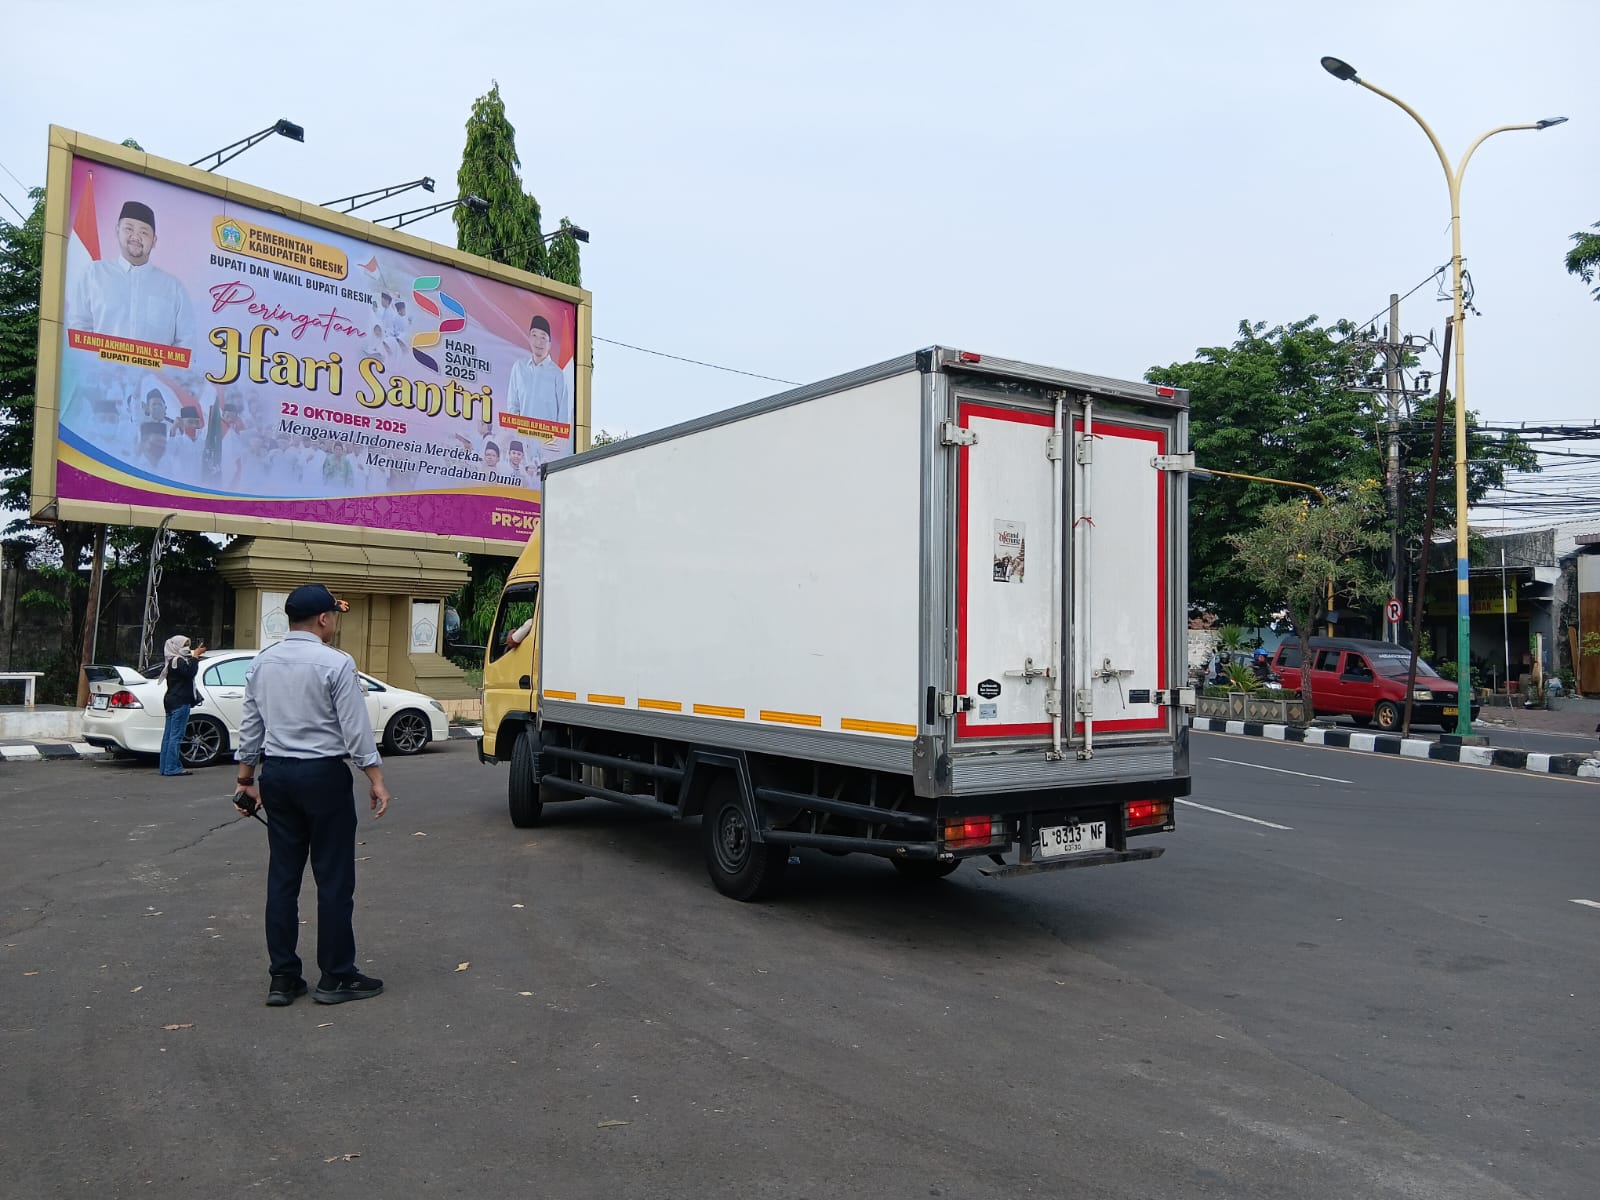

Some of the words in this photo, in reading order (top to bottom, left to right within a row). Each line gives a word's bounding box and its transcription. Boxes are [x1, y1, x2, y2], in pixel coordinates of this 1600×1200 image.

[250, 229, 313, 255] PEMERINTAH
[249, 241, 306, 264] KABUPATEN
[310, 257, 344, 275] GRESIK
[210, 254, 246, 272] BUPATI
[250, 264, 270, 278] DAN
[273, 269, 303, 287] WAKIL
[306, 279, 338, 296] BUPATI
[341, 288, 373, 304] GRESIK
[208, 280, 367, 342] Peringatan
[83, 335, 104, 348] FANDI
[104, 339, 135, 353] AKHMAD
[445, 338, 475, 356] HARI
[100, 350, 130, 363] BUPATI
[131, 356, 160, 368] GRESIK
[205, 323, 343, 396] Hari
[356, 357, 493, 424] Santri
[444, 364, 476, 380] 2025
[445, 352, 490, 372] SANTRI
[281, 402, 299, 416] 22
[303, 406, 370, 428] OKTOBER
[376, 418, 407, 434] 2025
[279, 419, 354, 443] Mengawal
[356, 431, 422, 453] Indonesia
[366, 453, 416, 472] Menuju
[418, 460, 486, 482] Peradaban
[488, 472, 522, 486] Dunia
[1041, 832, 1048, 847] L
[1056, 826, 1082, 844] 8313
[1090, 824, 1104, 840] NF
